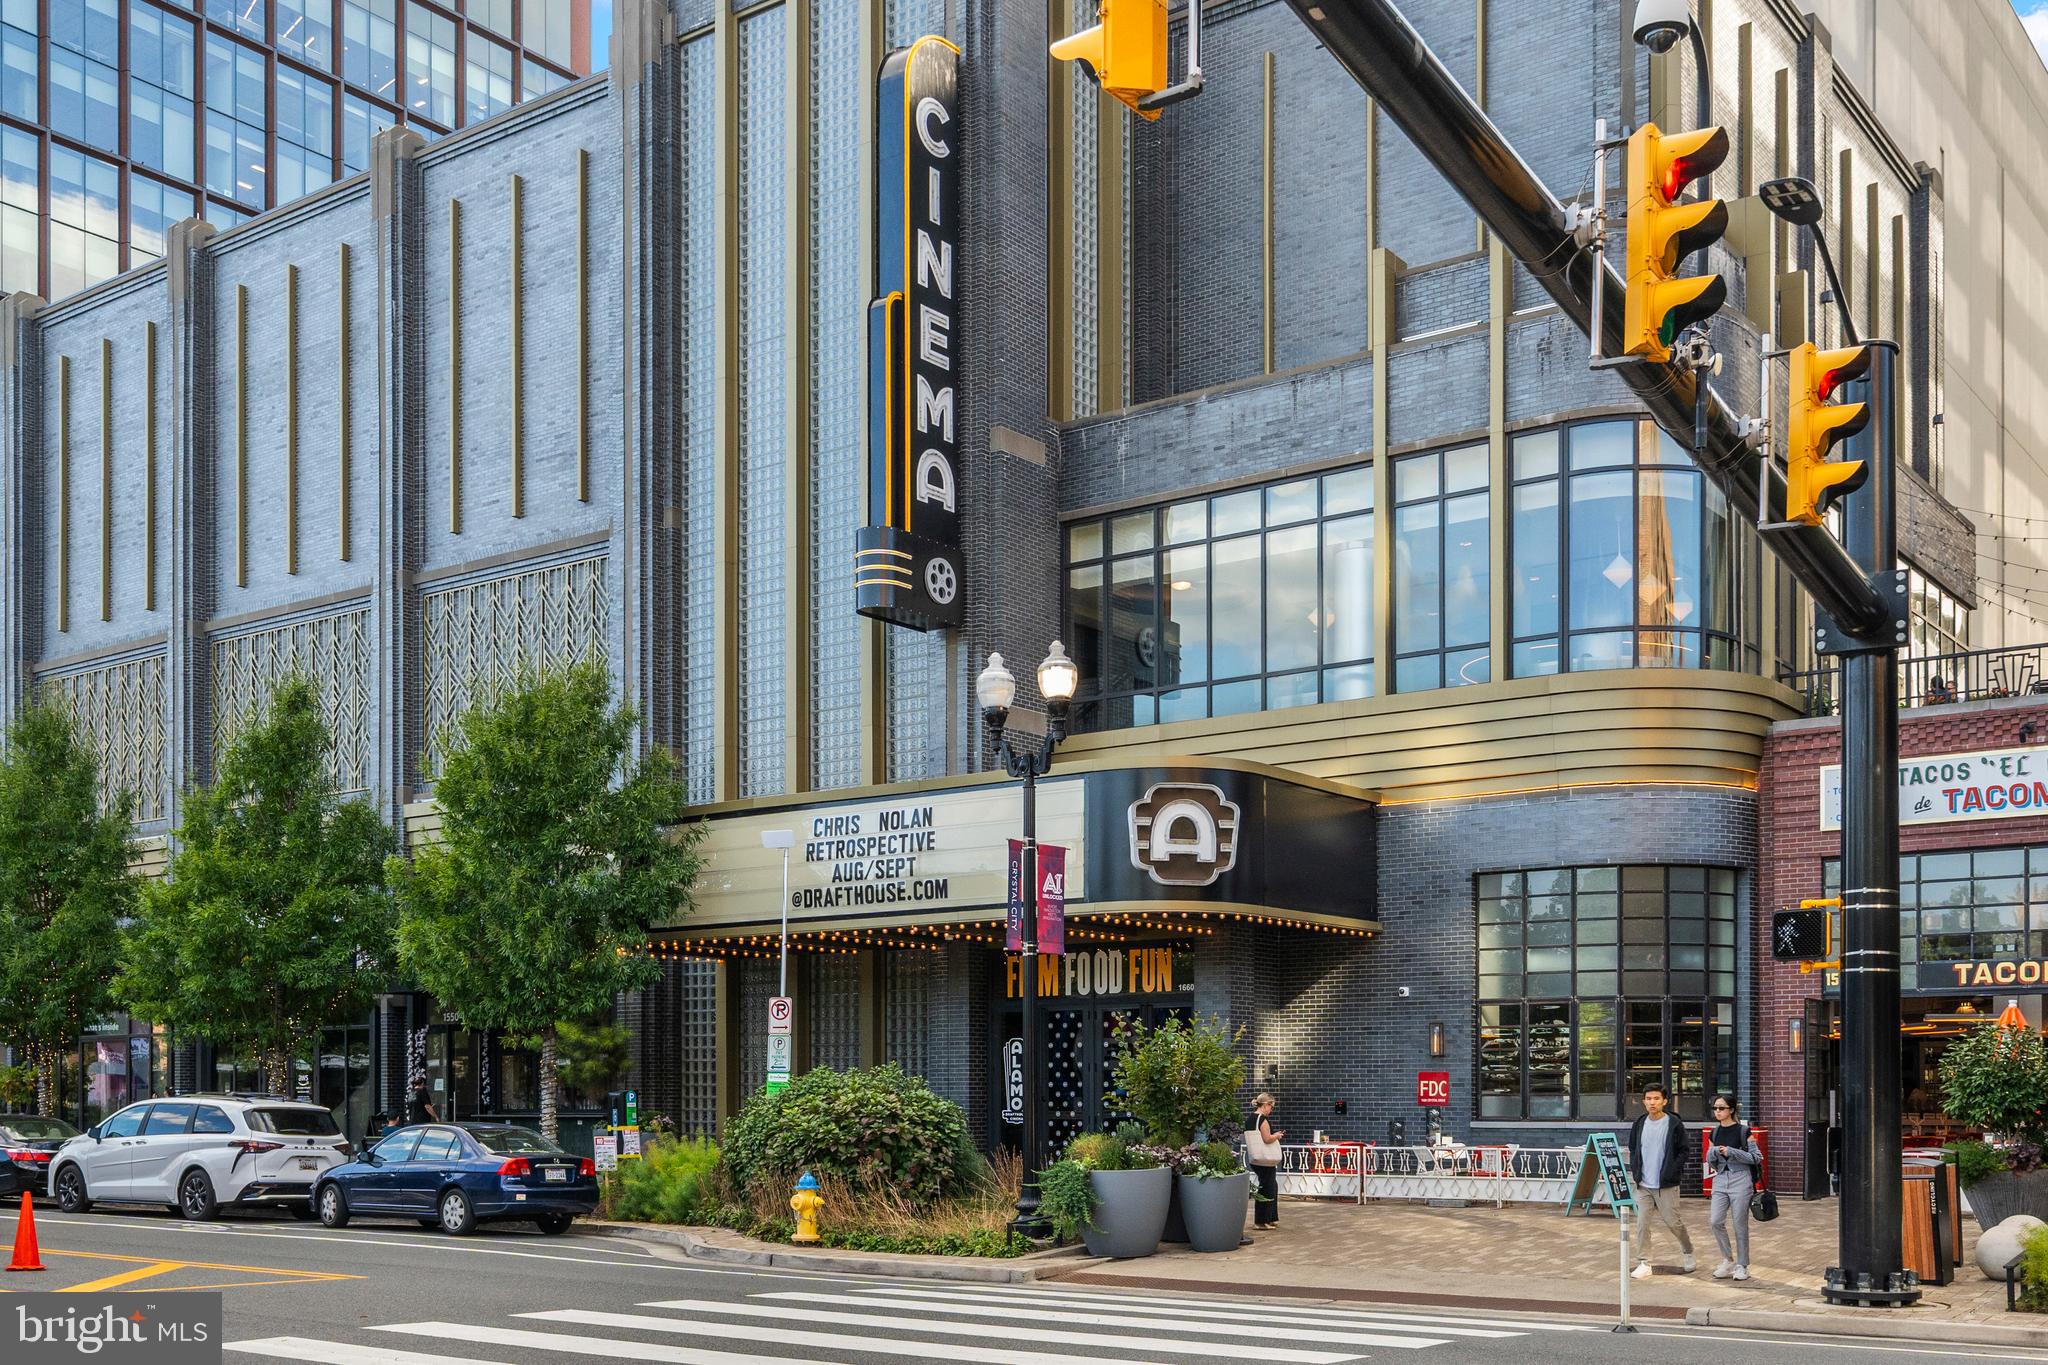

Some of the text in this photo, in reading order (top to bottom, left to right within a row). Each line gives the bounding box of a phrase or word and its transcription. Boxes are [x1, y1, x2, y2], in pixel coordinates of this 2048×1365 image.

[915, 96, 955, 514] CINEMA
[1914, 796, 1931, 812] de
[813, 807, 933, 838] CHRIS NOLAN
[806, 831, 936, 862] RETROSPECTIVE
[831, 857, 917, 883] AUG/SEPT
[791, 879, 949, 909] @DRAFTHOUSE.COM
[1010, 860, 1019, 931] CRYSTAL CITY
[1007, 948, 1173, 998] FIM FOOD FUN
[1010, 1041, 1024, 1111] ALAMO
[1420, 1080, 1447, 1097] FDC
